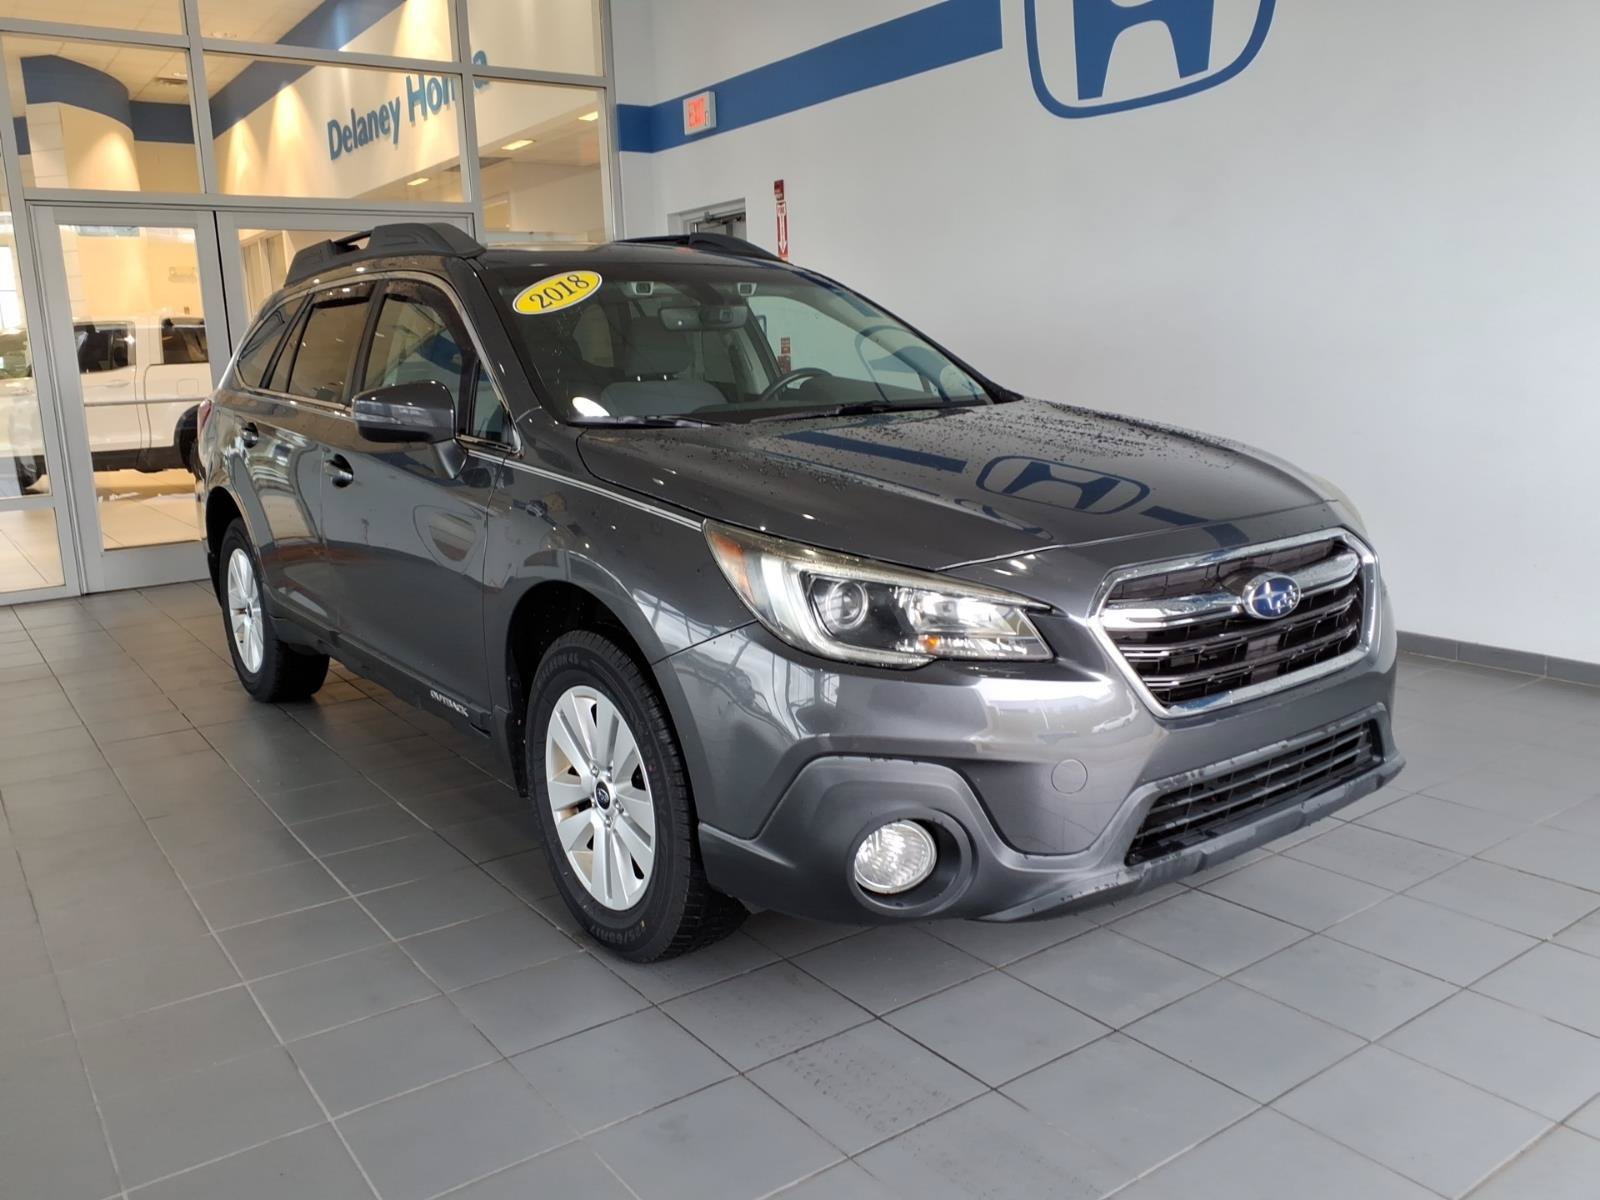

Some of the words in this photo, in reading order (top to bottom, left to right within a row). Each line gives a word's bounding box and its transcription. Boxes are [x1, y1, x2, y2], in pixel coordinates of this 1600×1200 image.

[327, 96, 401, 161] Delaney
[405, 50, 490, 123] Hona
[529, 274, 590, 309] 2018
